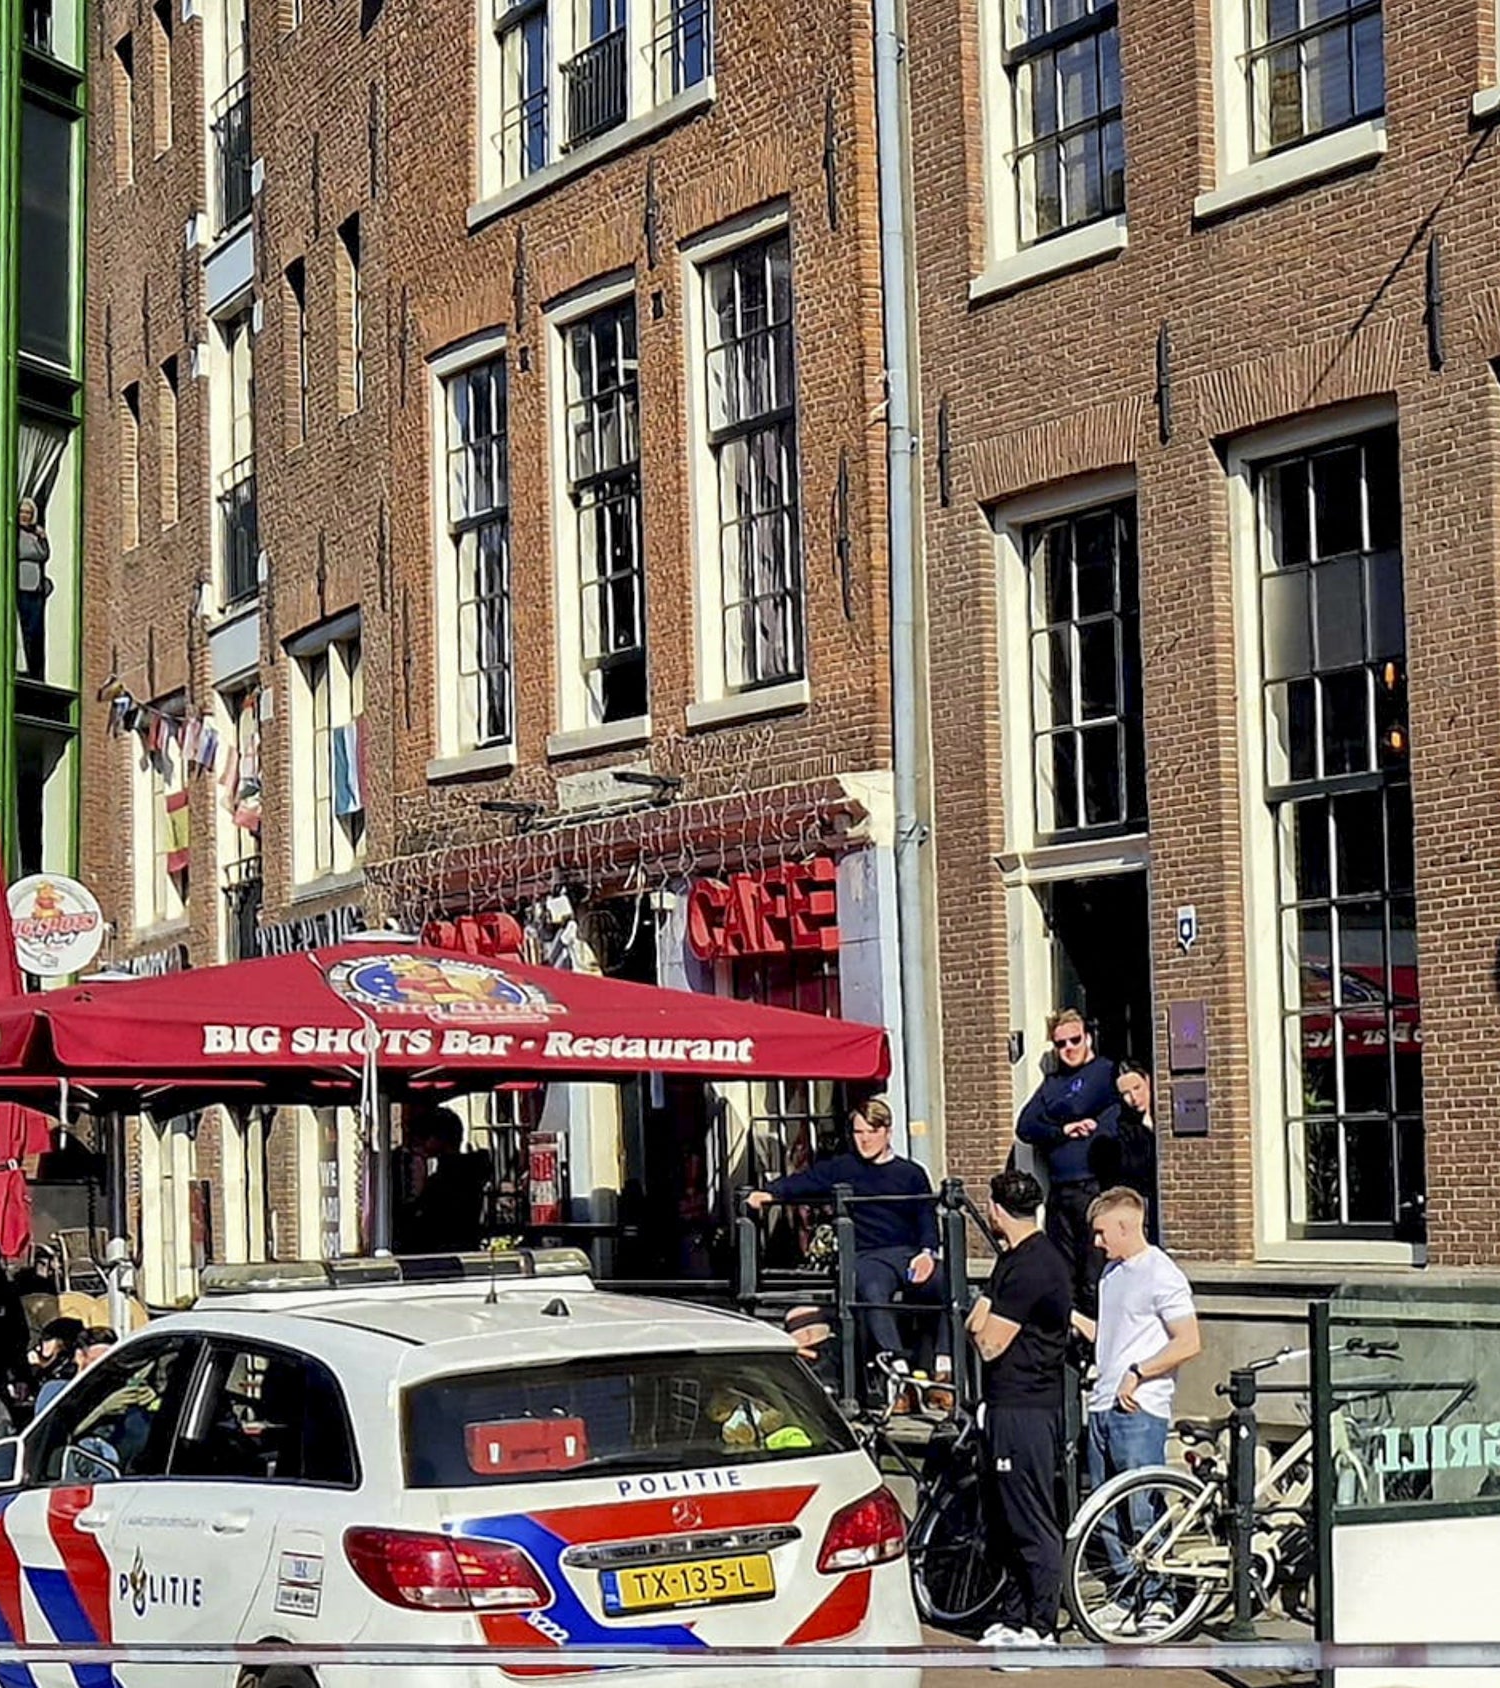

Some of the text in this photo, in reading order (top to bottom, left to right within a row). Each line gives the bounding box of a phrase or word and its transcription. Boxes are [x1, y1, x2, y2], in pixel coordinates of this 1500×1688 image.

[686, 857, 839, 961] CAFE
[202, 1025, 280, 1054] BIG
[290, 1026, 432, 1055] SHOTS
[440, 1029, 514, 1057] Bar
[543, 1031, 755, 1063] Restaurant
[617, 1469, 742, 1497] POLITIE
[118, 1571, 202, 1617] POLITIE
[633, 1562, 755, 1600] TX-135-L
